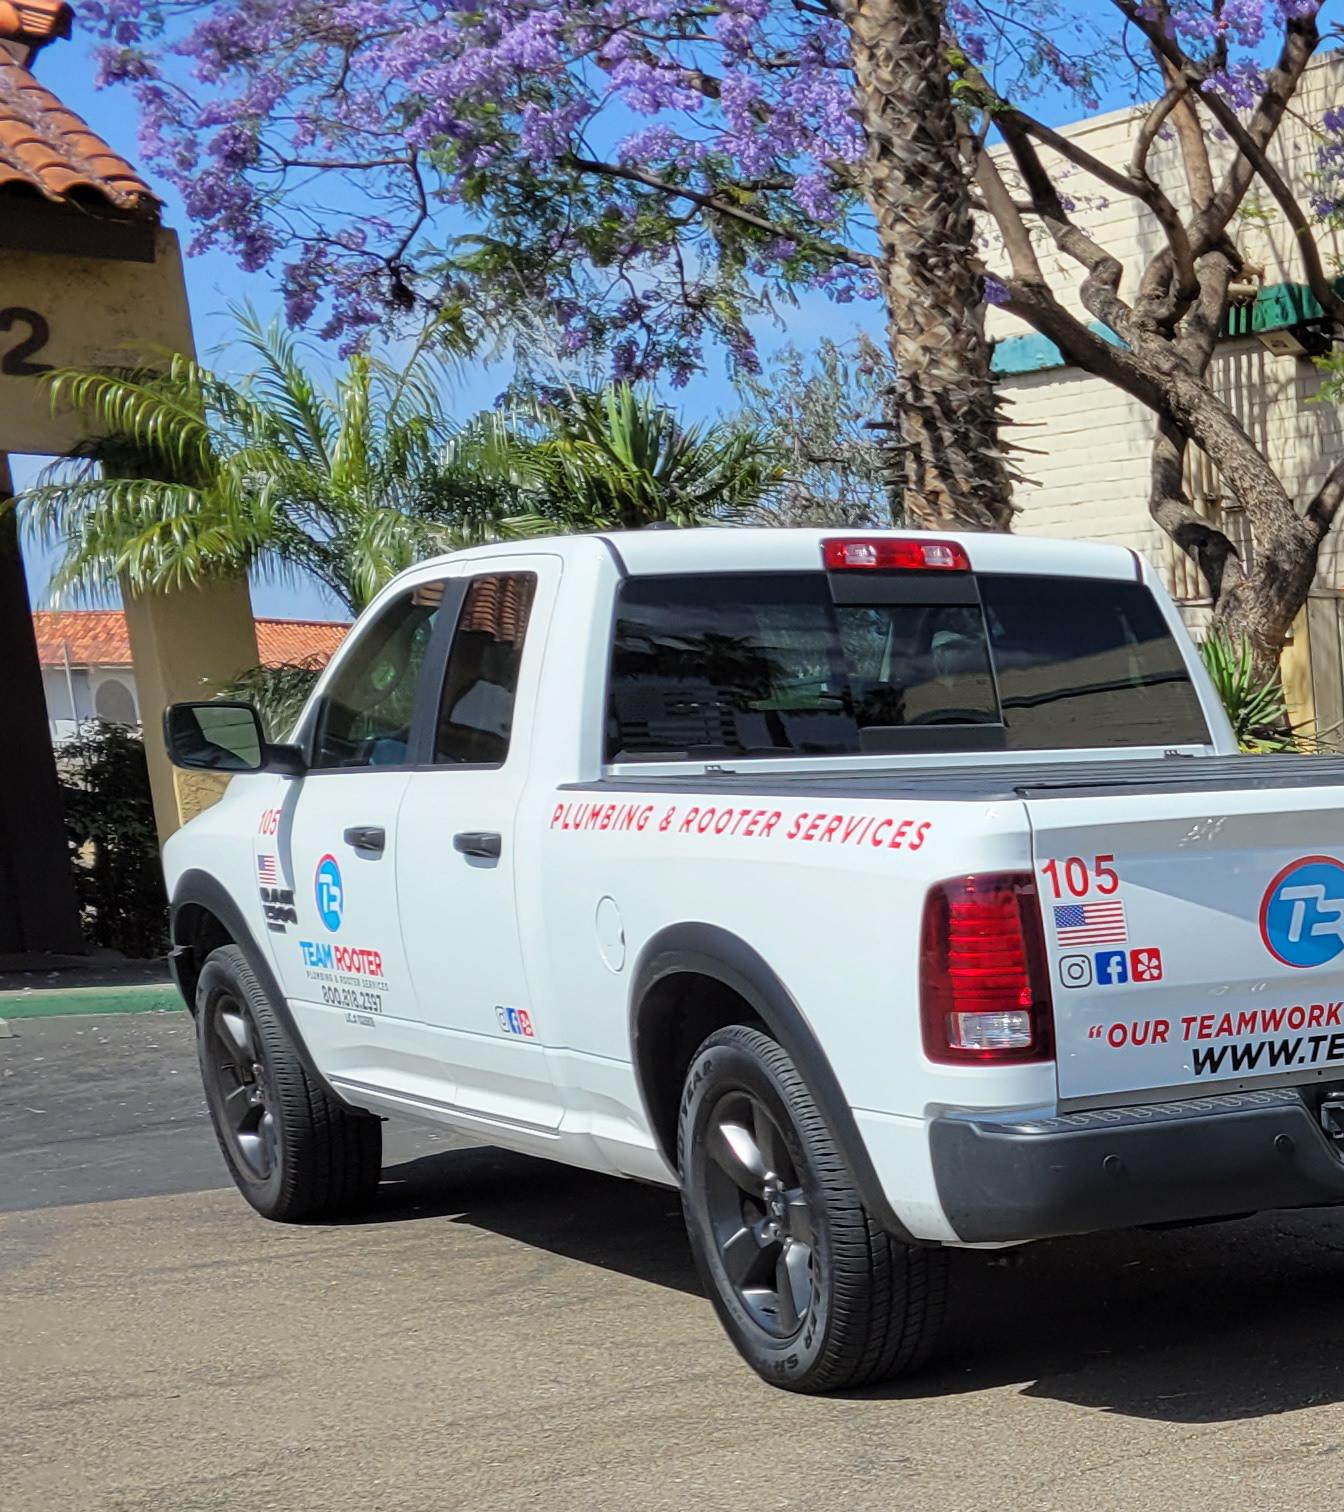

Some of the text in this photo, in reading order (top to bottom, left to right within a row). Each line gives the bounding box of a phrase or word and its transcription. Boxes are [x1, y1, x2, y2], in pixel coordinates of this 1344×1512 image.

[258, 808, 283, 835] 105
[550, 803, 932, 852] PLUMBING & ROOTER SERVICES
[1041, 854, 1119, 898] 105
[299, 941, 384, 977] TEAM ROOTER
[322, 985, 382, 1013] 800.818.2397
[1181, 1001, 1344, 1041] TEAMWORK
